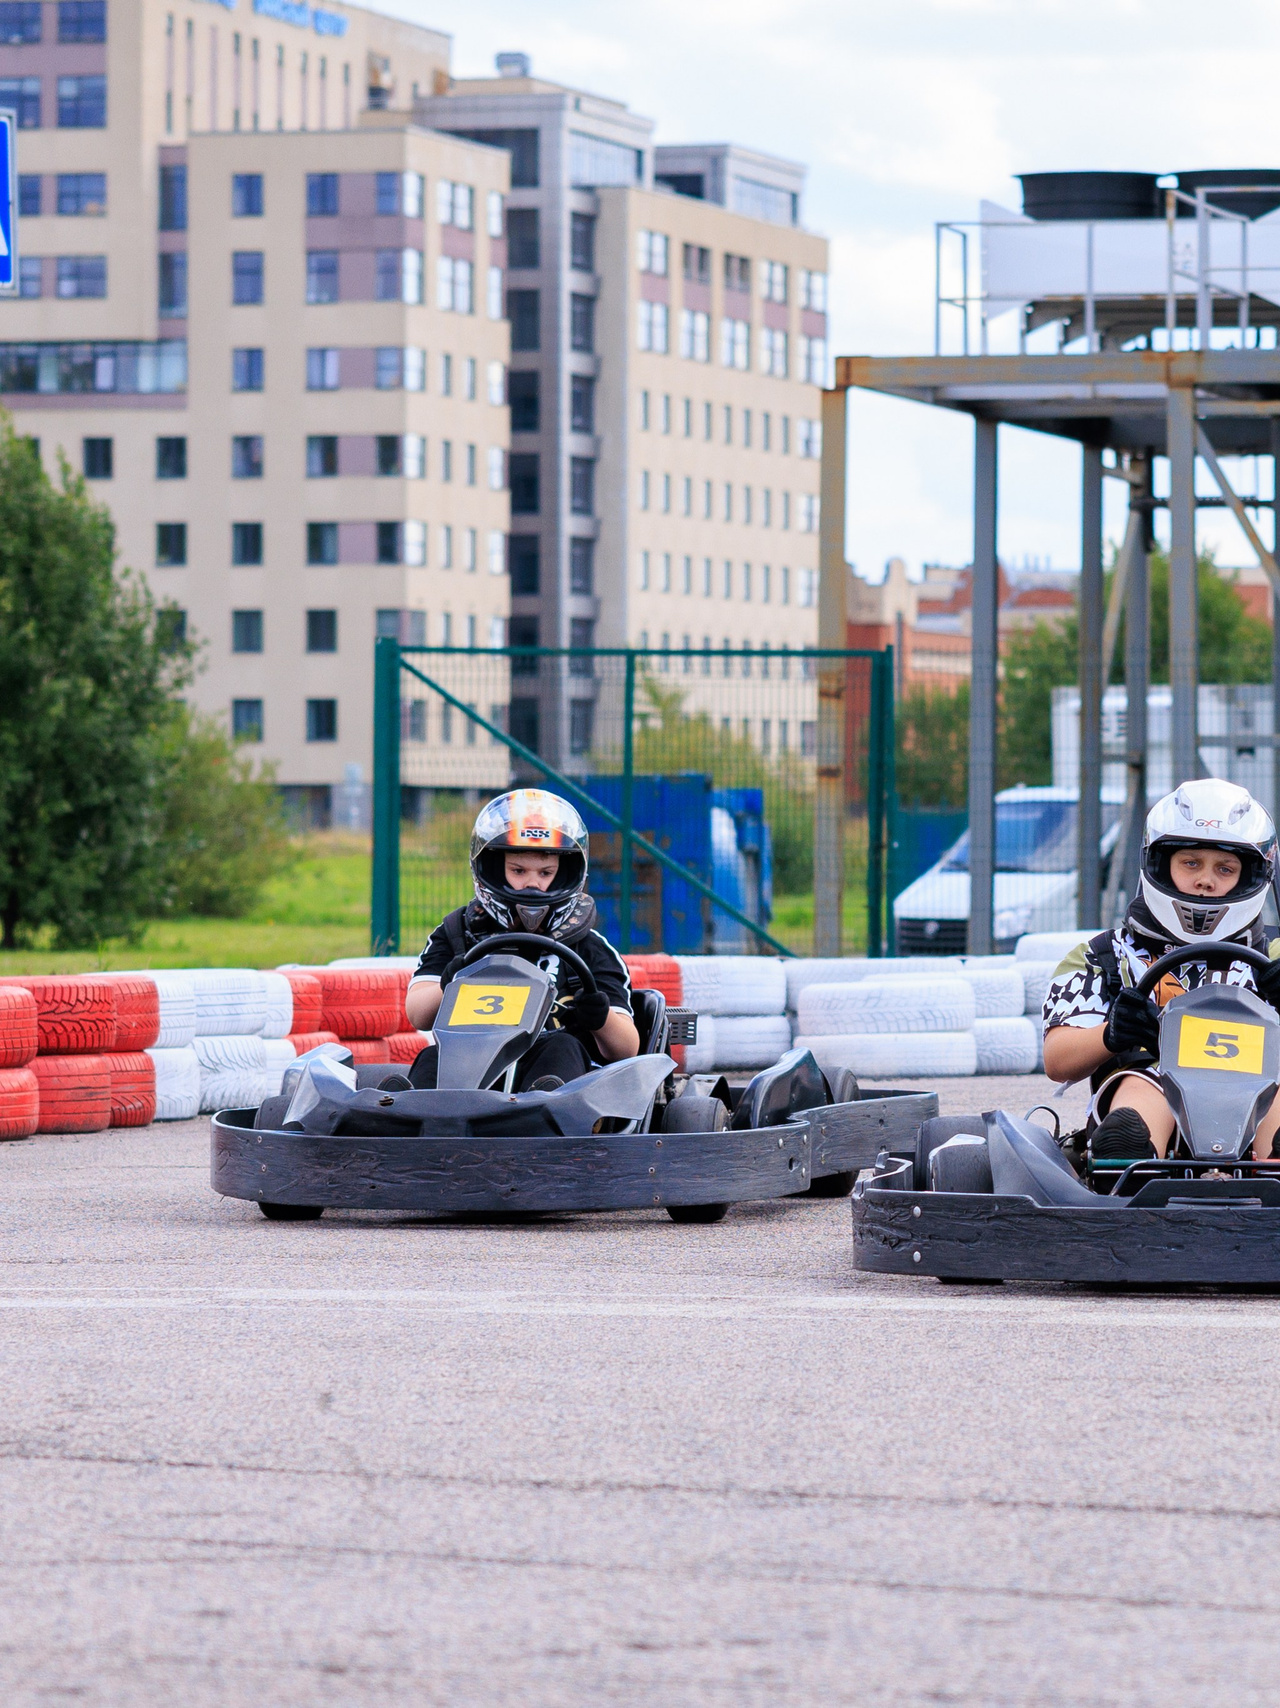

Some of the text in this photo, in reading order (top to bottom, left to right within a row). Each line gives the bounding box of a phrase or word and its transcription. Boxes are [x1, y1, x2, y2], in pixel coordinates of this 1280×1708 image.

[1195, 819, 1223, 829] GXT
[473, 995, 505, 1015] 3
[1202, 1032, 1240, 1059] 5
